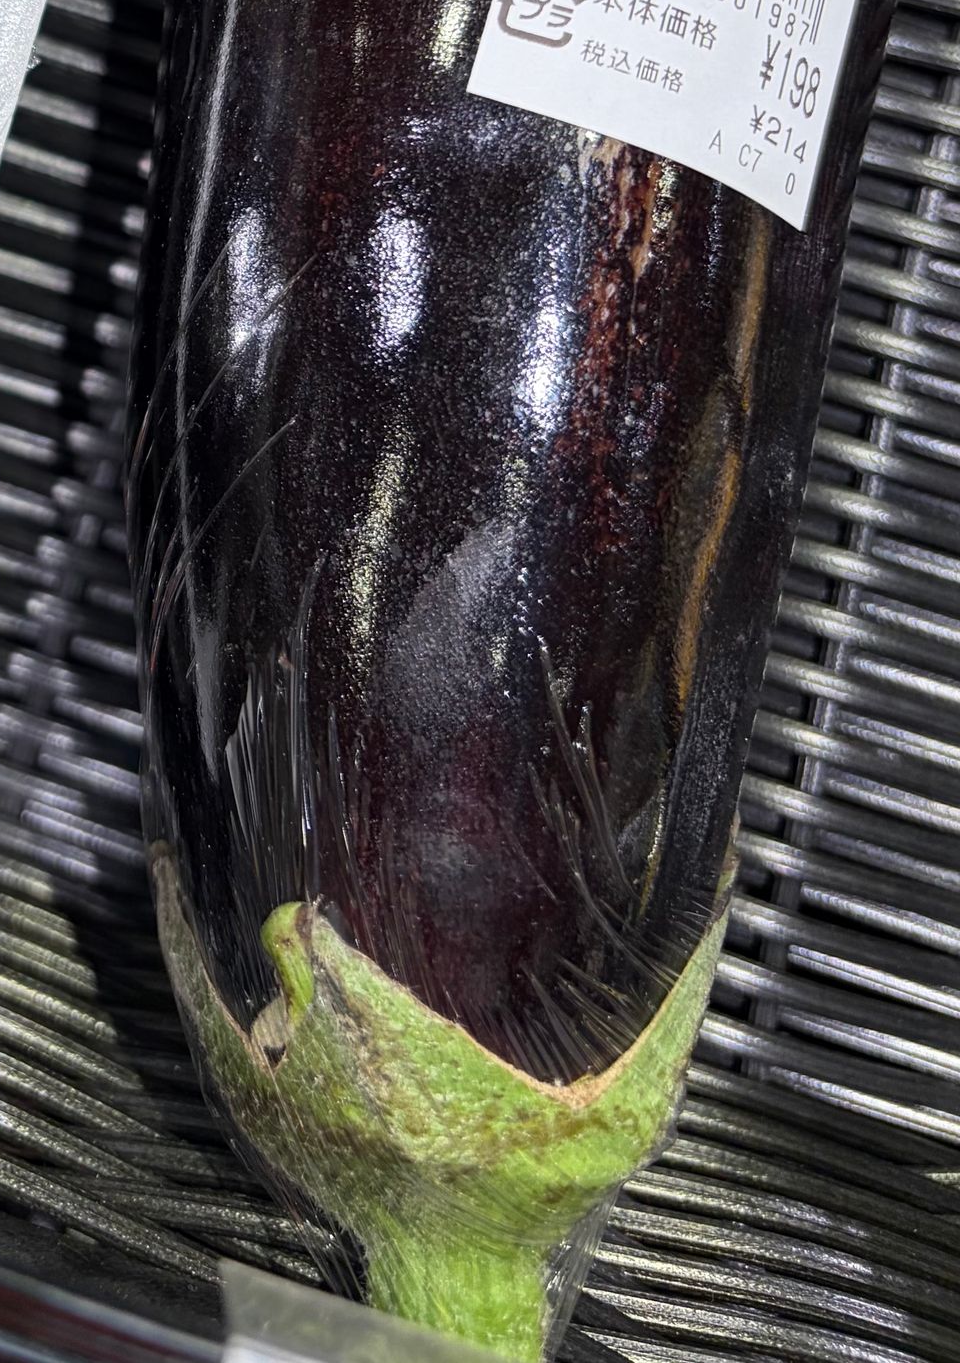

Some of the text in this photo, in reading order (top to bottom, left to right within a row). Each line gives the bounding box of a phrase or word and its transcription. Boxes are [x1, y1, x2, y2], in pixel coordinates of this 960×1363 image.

[581, 40, 808, 164] 税込価格 ¥214
[759, 34, 822, 118] ¥198
[709, 129, 722, 153] A
[738, 144, 763, 172] C7
